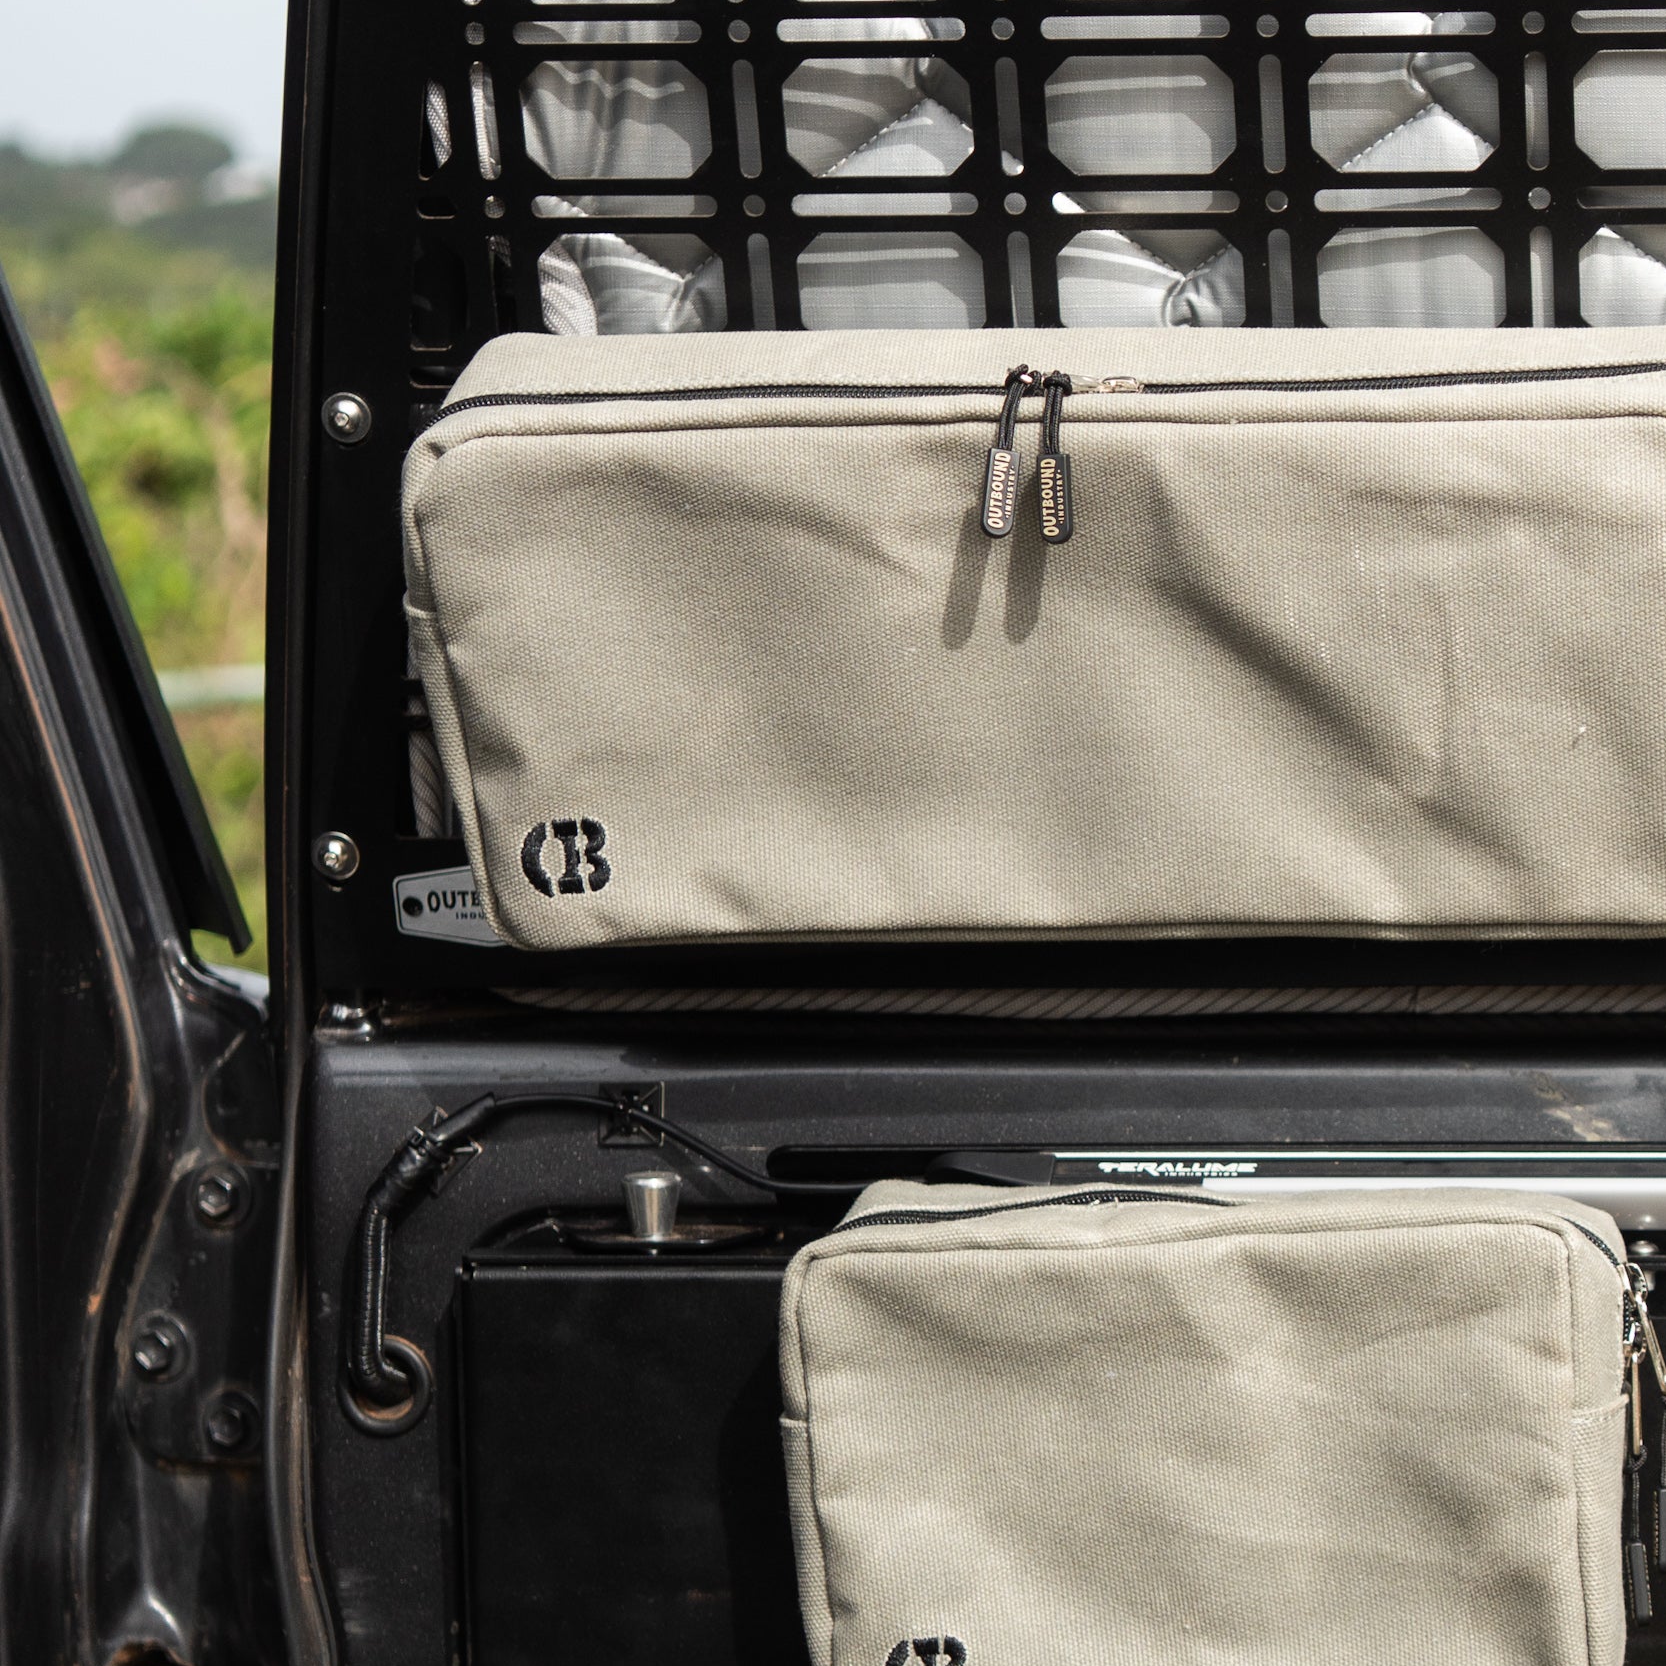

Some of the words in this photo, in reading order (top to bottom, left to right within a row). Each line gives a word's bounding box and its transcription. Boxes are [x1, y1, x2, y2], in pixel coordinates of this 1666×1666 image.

[987, 452, 1011, 529] OUTBOUND
[1040, 458, 1060, 537] OUTBOUND
[1098, 1162, 1258, 1176] TERALUME
